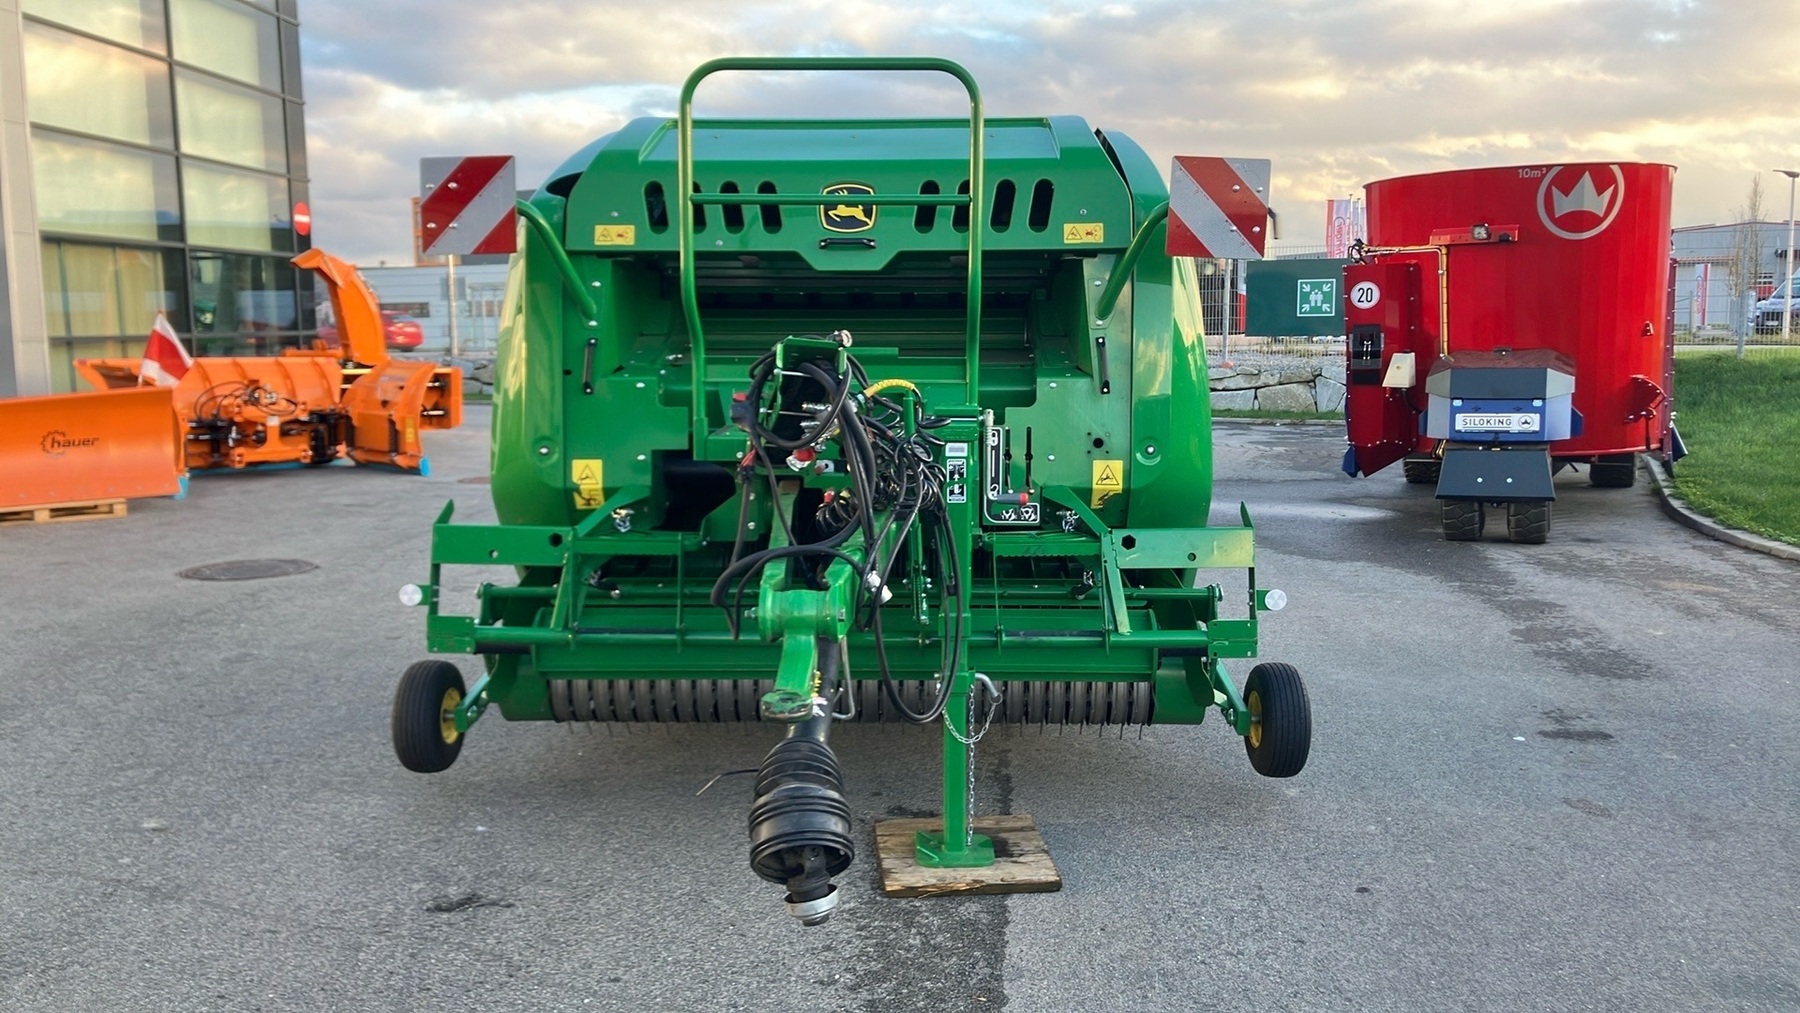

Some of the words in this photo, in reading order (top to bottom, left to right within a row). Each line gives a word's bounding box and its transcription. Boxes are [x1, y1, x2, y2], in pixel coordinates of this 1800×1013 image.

[1357, 287, 1373, 303] 20
[1462, 418, 1512, 426] SILOKING
[51, 436, 100, 449] hauer
